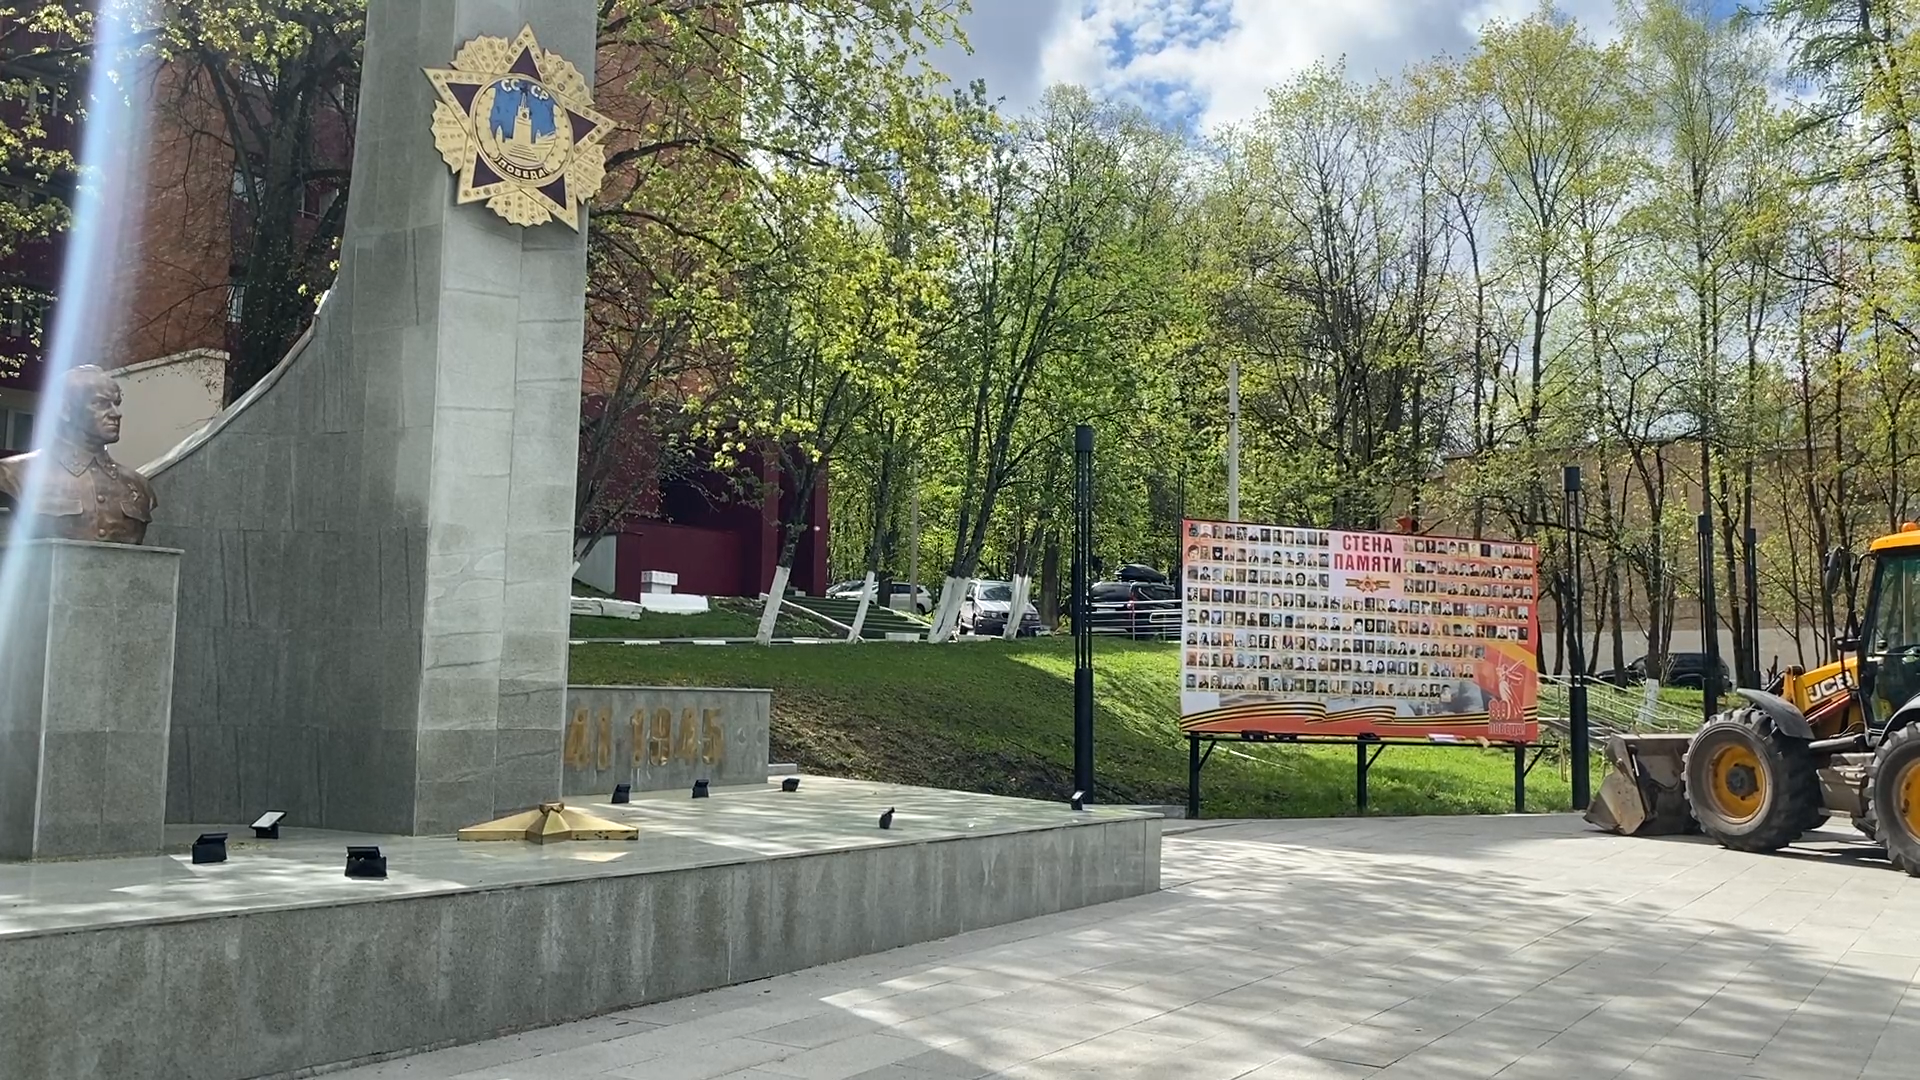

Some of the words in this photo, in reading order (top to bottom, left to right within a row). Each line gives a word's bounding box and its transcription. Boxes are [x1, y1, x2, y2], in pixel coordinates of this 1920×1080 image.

[498, 159, 547, 180] ПОБЕДА
[1343, 534, 1393, 553] СТЕНА
[1334, 553, 1402, 573] ПАМЯТИ
[1807, 671, 1853, 701] JCB
[630, 707, 724, 768] 1945
